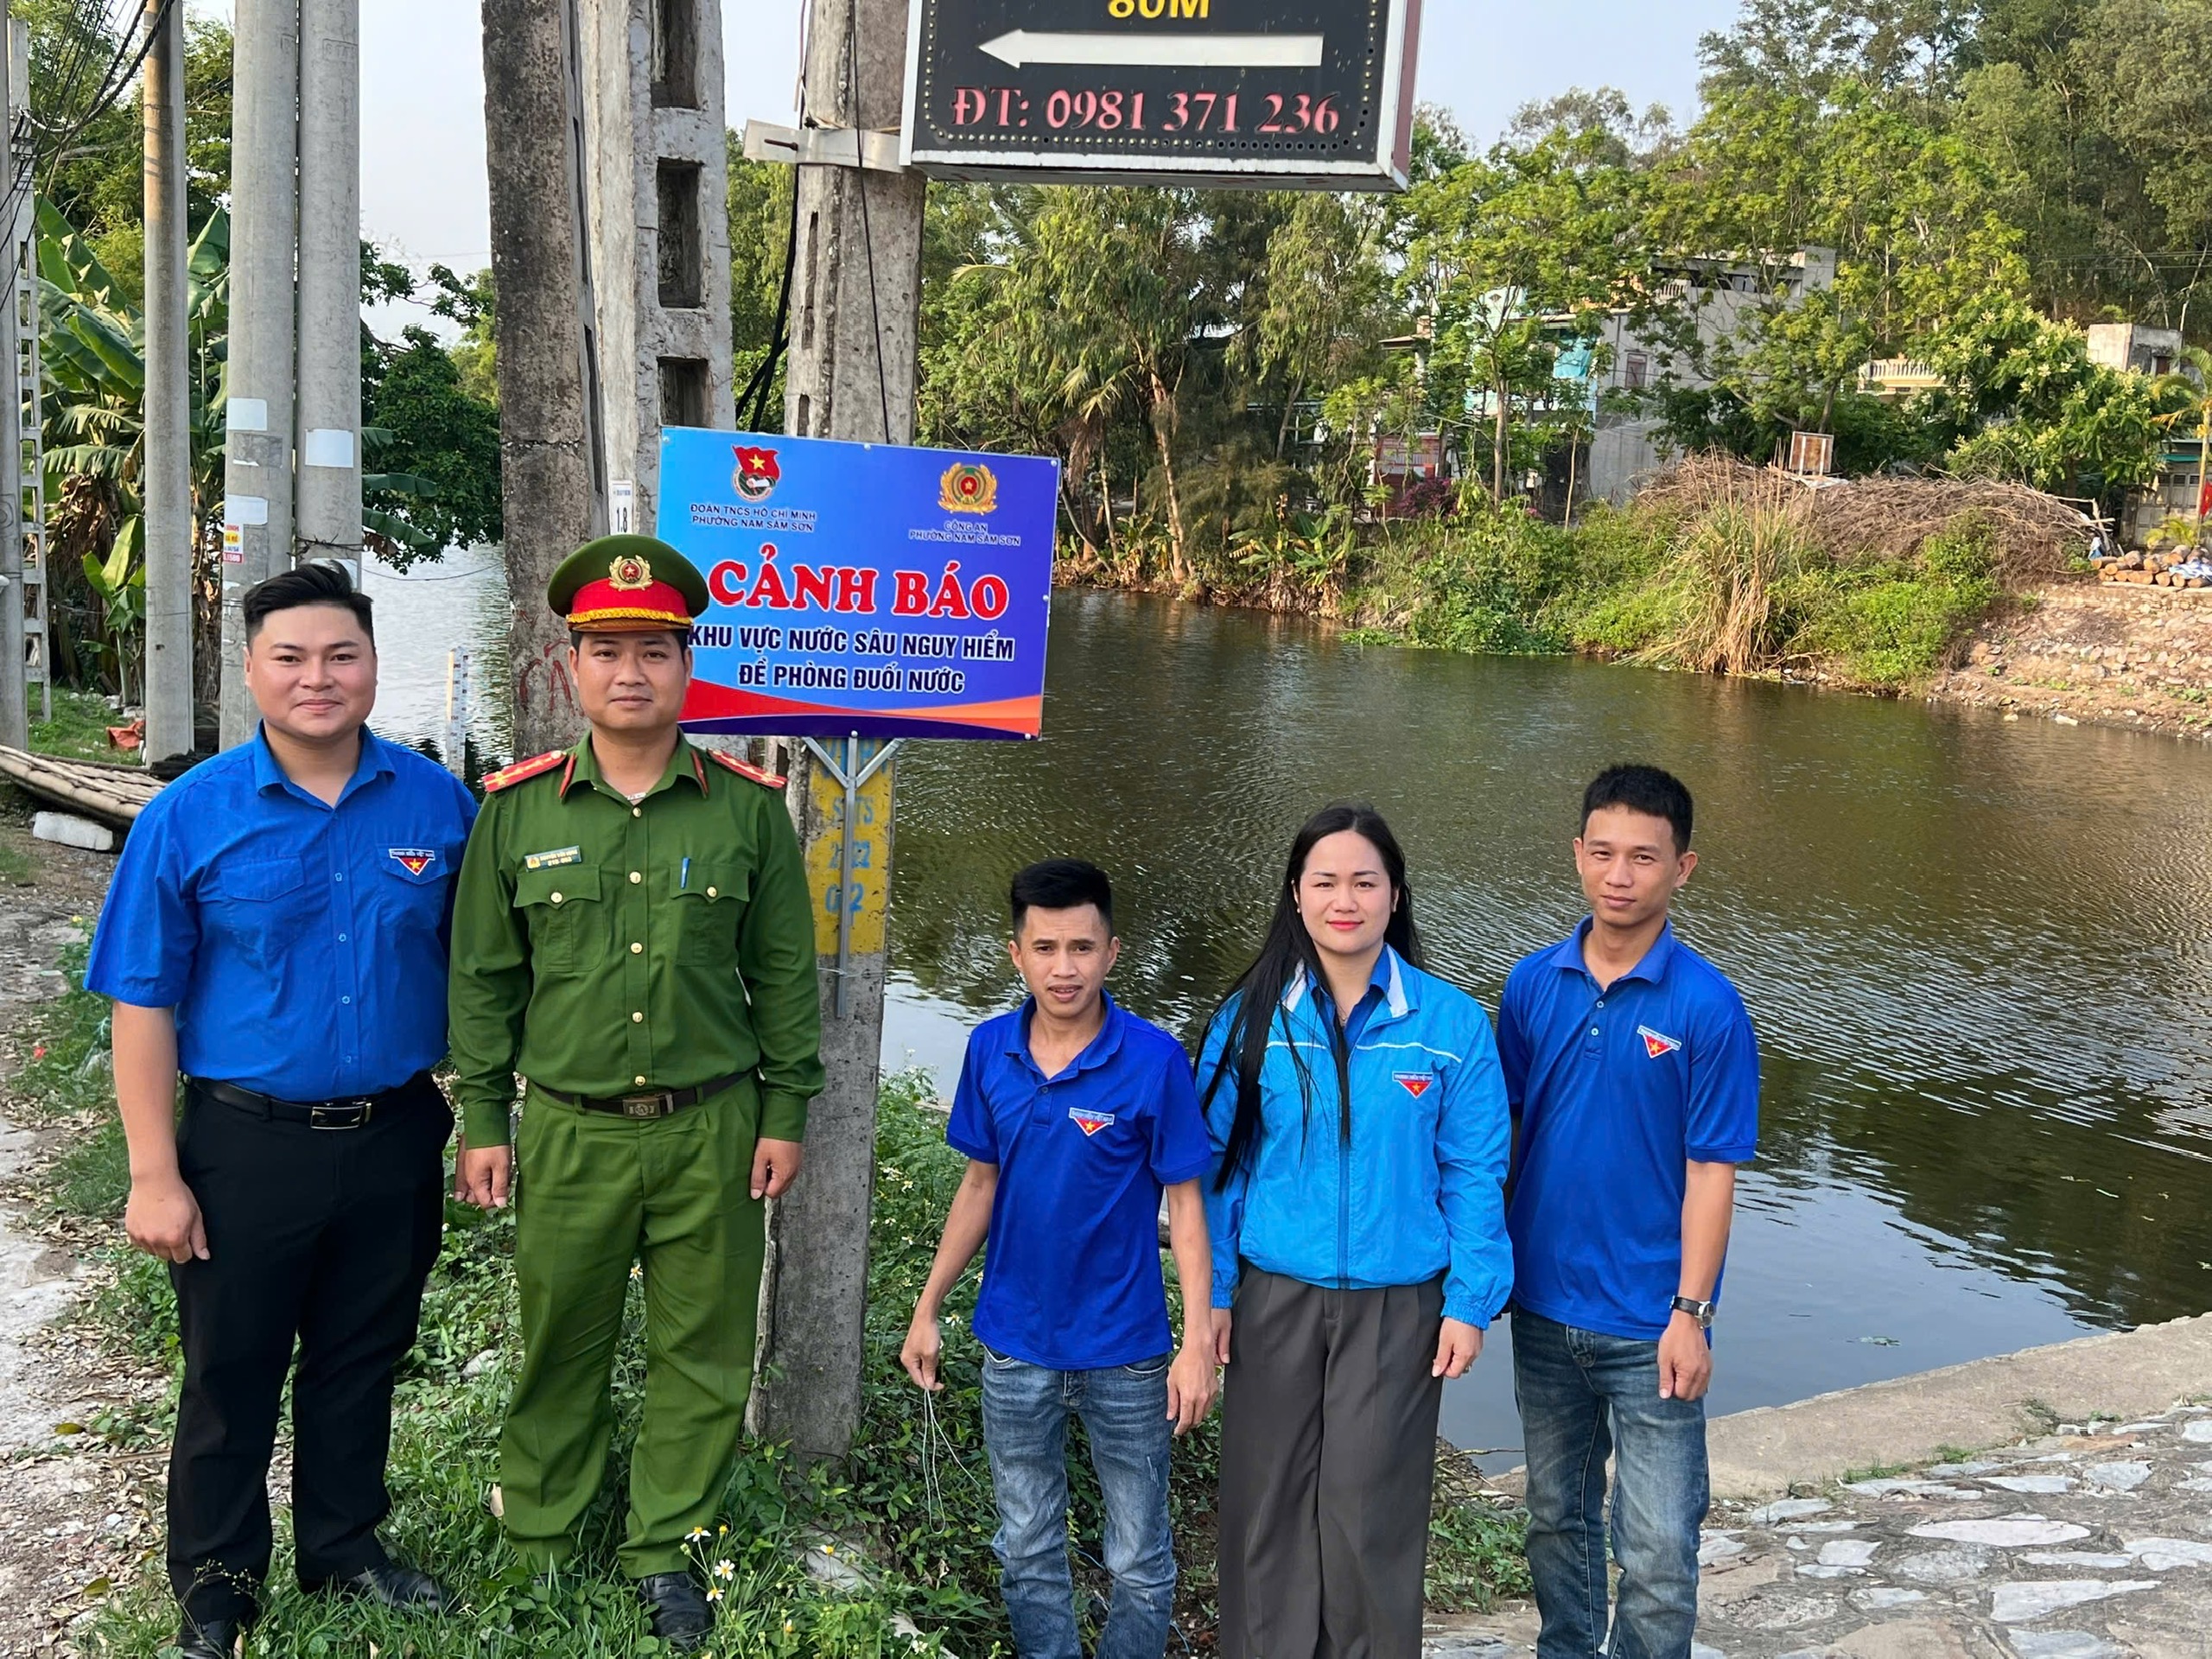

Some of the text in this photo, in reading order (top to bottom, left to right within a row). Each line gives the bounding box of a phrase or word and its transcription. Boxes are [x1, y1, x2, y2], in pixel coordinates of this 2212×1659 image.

[951, 86, 1340, 133] ĐT: 0981 371 236
[723, 505, 750, 516] TNCS
[791, 510, 816, 520] MINH
[741, 518, 764, 529] NAM
[954, 532, 976, 543] NAM
[974, 523, 988, 532] AN
[709, 544, 1009, 620] CẢNH BÁO
[688, 625, 1014, 659] KHU VỰC NƯỚC SÂU NGUY HIỂM
[739, 658, 965, 692] ĐỀ PHÒNG ĐUỐI NƯỚC
